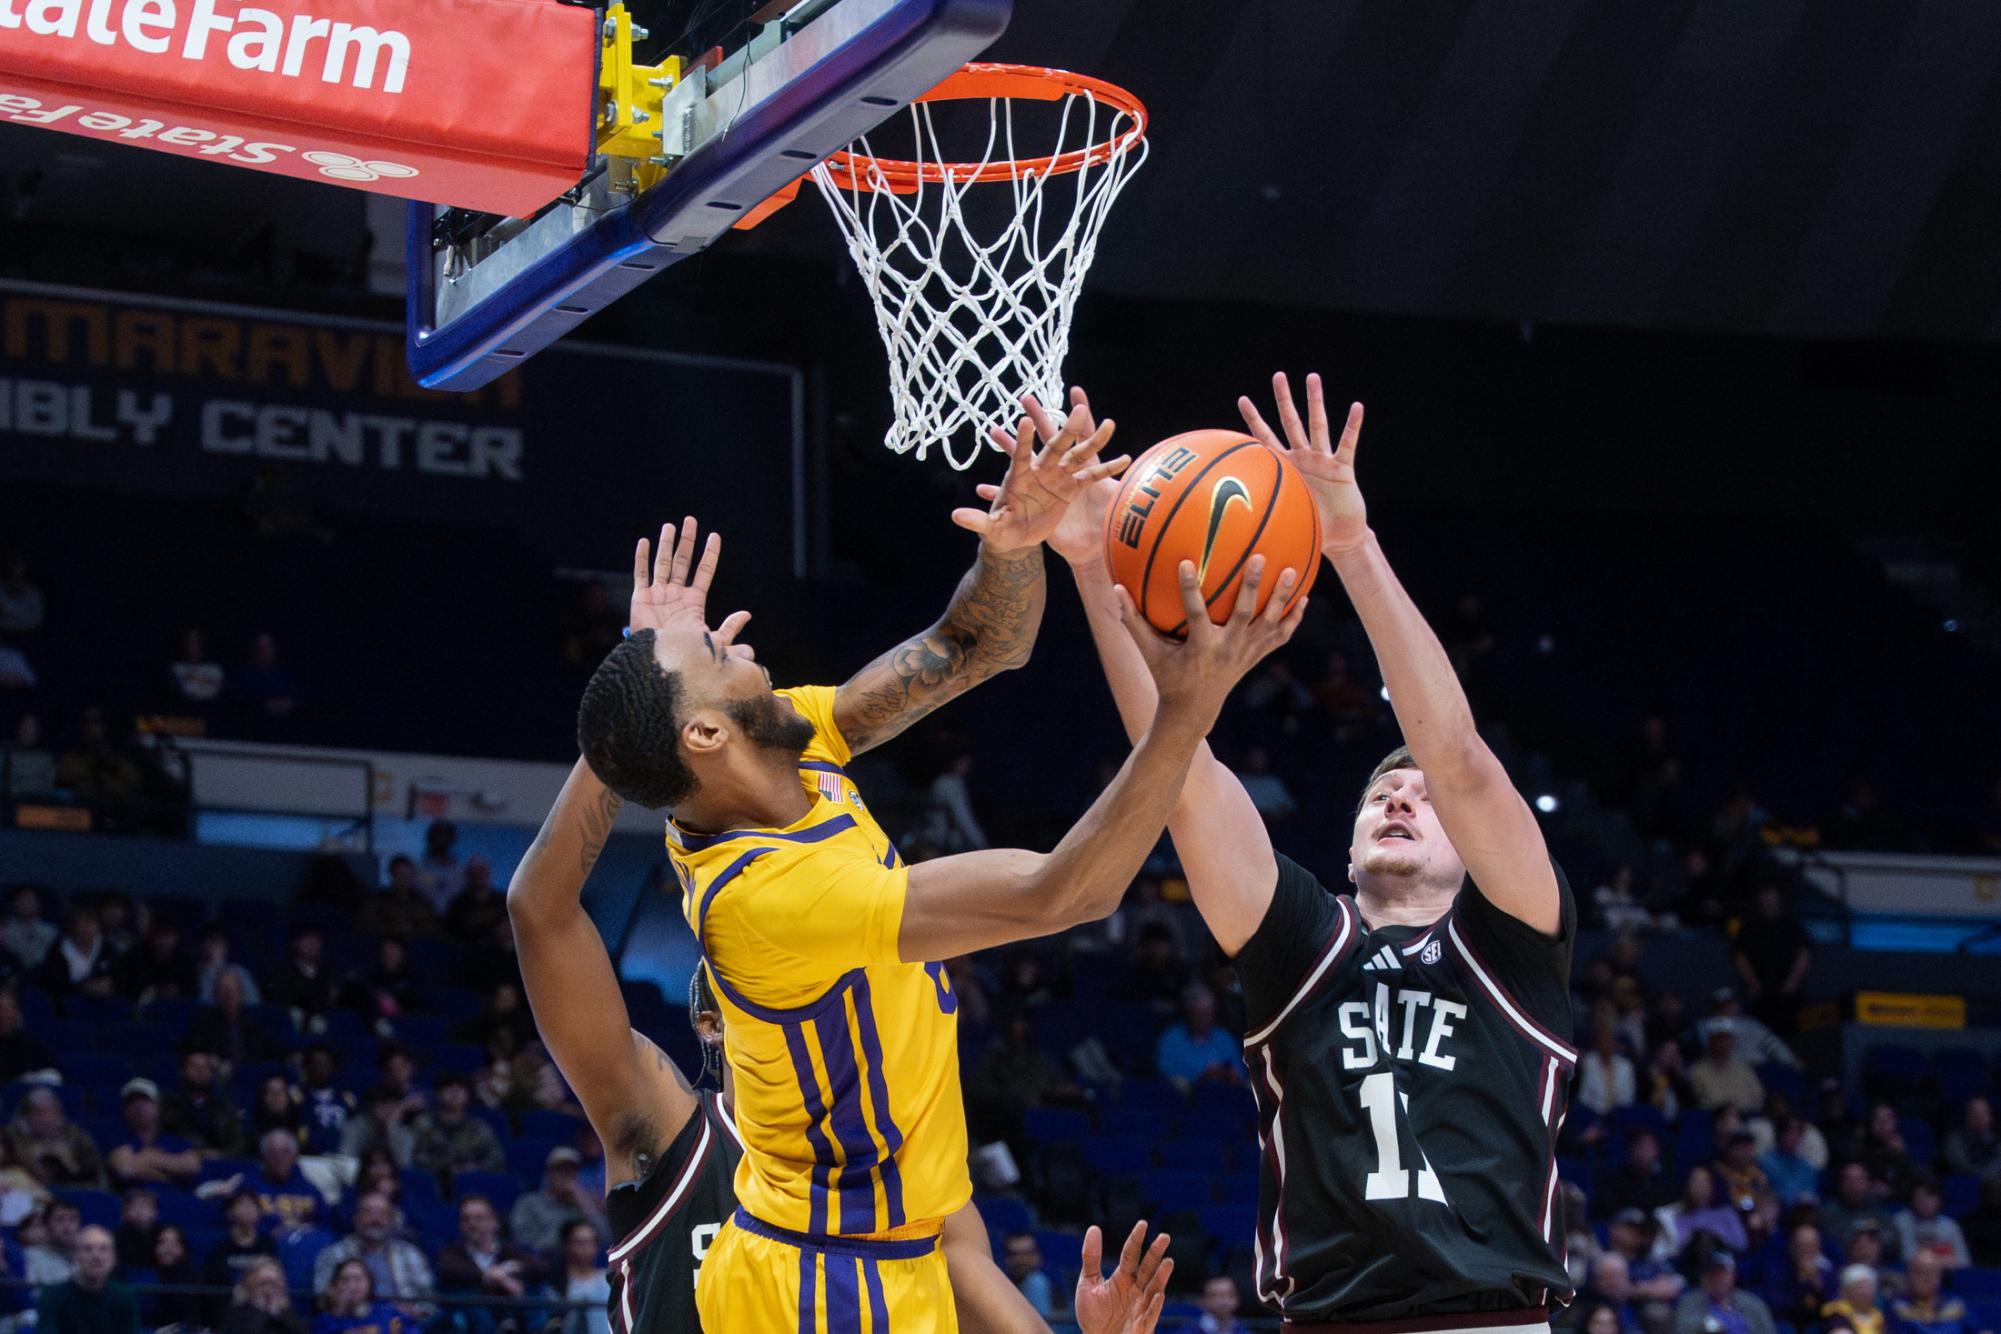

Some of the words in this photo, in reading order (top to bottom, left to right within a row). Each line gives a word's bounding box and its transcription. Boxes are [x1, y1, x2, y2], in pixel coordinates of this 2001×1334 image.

[182, 0, 411, 94] Farm
[78, 112, 297, 164] State
[4, 298, 523, 409] MARAVI
[202, 399, 524, 480] CENTER
[1119, 447, 1198, 550] ELITE
[1338, 982, 1468, 1071] SATE
